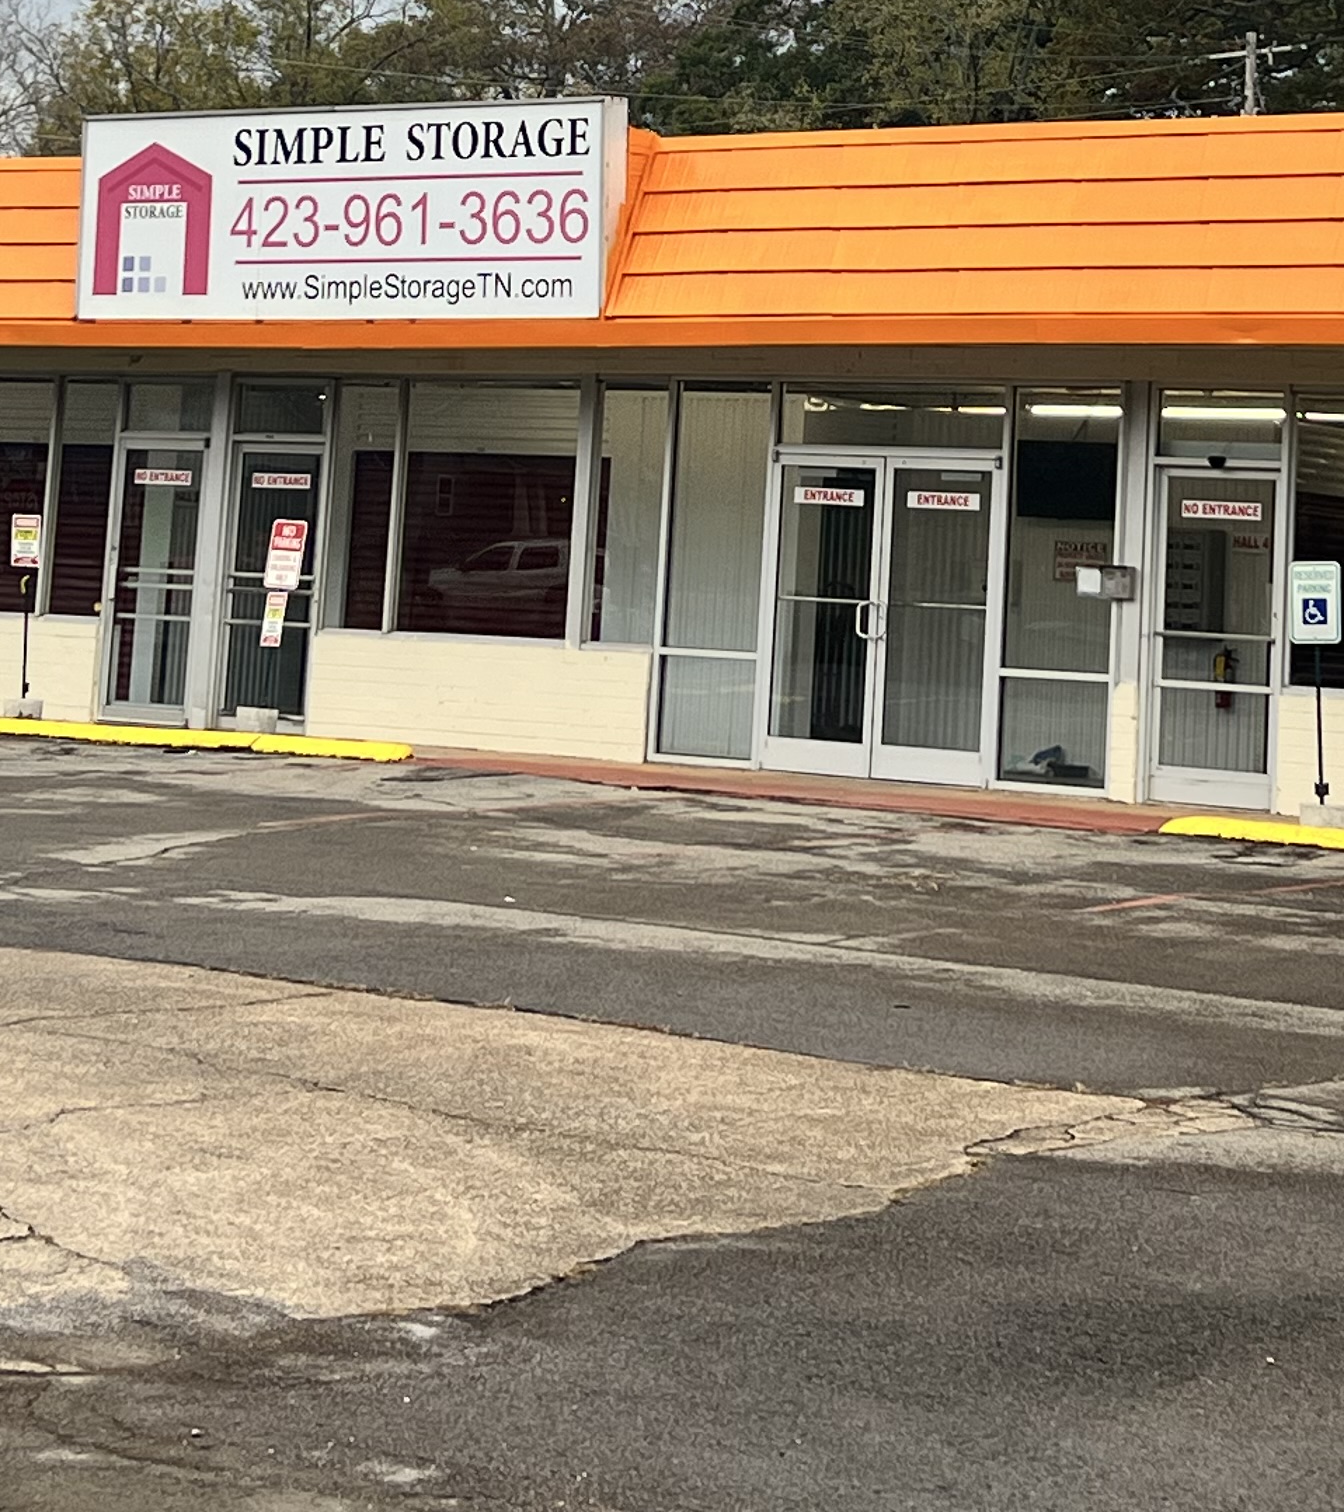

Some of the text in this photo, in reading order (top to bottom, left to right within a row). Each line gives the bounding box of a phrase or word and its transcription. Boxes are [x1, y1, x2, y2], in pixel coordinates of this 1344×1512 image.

[233, 117, 591, 166] SIMPLE STORAGE
[127, 183, 182, 201] SIMPLE
[124, 203, 184, 220] STORAGE
[230, 187, 590, 248] 423-961-3636
[242, 272, 573, 305] www.SimpleStorageTN.com
[136, 471, 191, 483] NO ENTRANCE
[267, 476, 309, 486] ENTRANCE
[804, 489, 855, 503] ENTRANCE
[917, 493, 969, 507] ENTRANCE
[1183, 502, 1260, 518] NO ENTRANCE
[282, 525, 297, 537] NO
[1056, 541, 1105, 553] NOTICE
[1232, 535, 1259, 548] HALL
